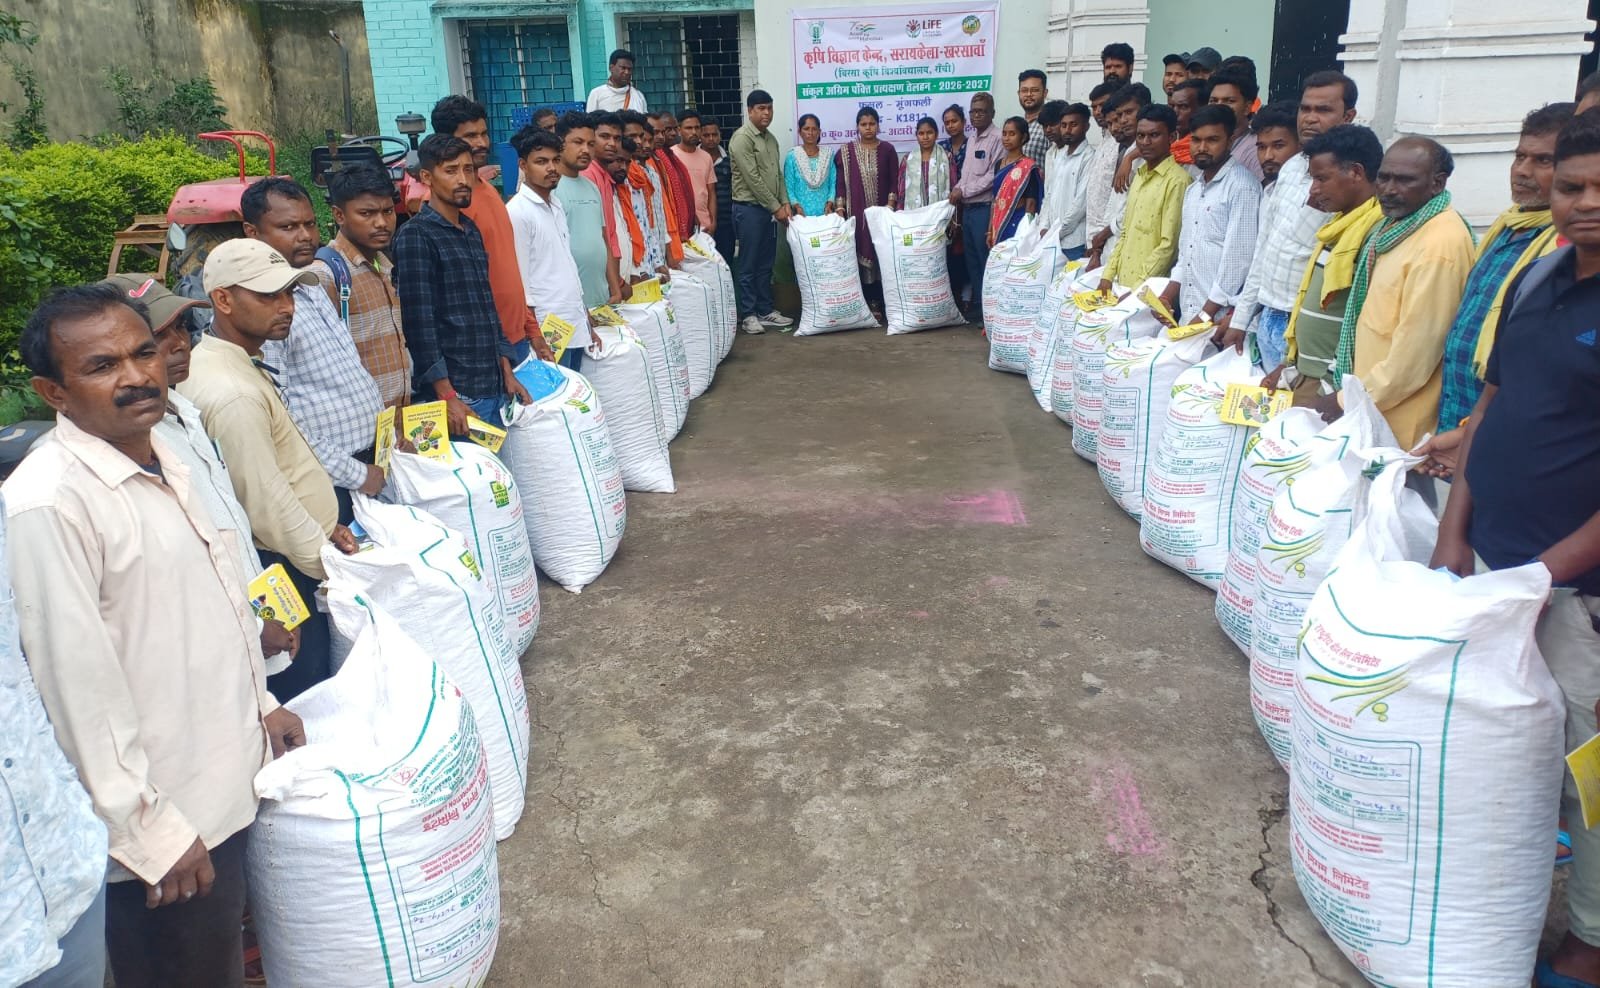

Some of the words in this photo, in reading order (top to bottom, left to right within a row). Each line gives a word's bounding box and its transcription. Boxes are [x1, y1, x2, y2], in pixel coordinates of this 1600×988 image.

[803, 46, 825, 69] कृषि
[827, 45, 860, 65] विज्ञान
[906, 80, 931, 93] तेलहन
[938, 79, 989, 91] 2026-2027
[422, 807, 460, 833] लिमिटेड
[1332, 867, 1370, 891] लिमिटेड
[1342, 886, 1371, 900] LIMITED
